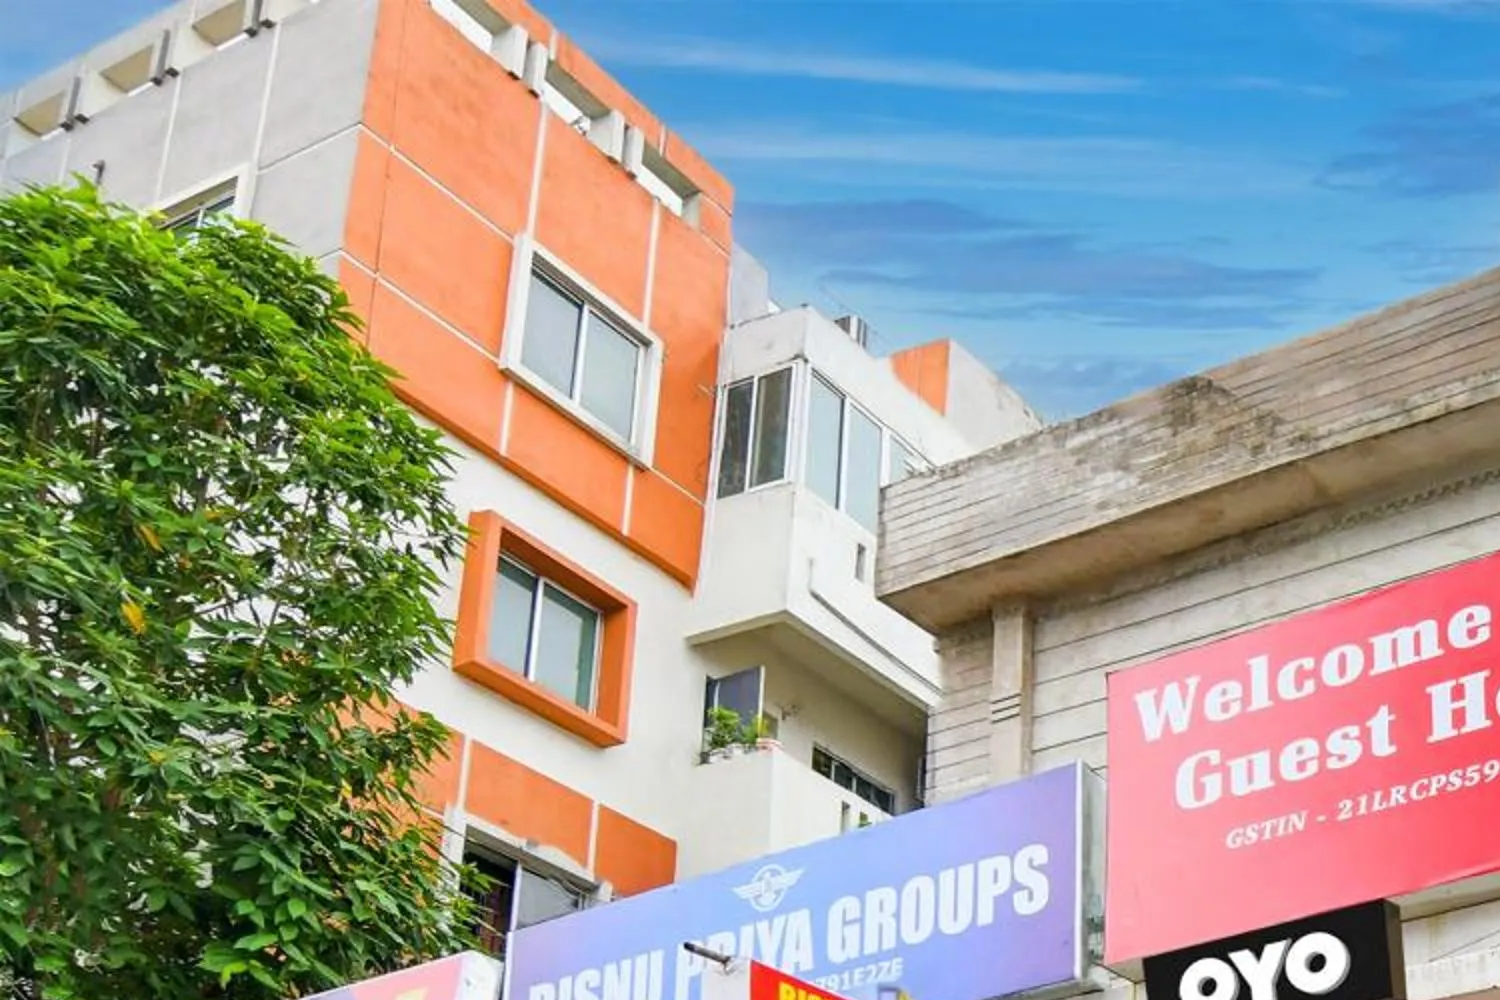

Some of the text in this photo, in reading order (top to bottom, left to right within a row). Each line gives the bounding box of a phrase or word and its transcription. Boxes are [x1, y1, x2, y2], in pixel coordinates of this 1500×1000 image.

[1134, 604, 1494, 743] Welcome
[1174, 701, 1398, 812] Guest
[1224, 807, 1307, 851] GSTIN
[826, 843, 1052, 966] GROUPS
